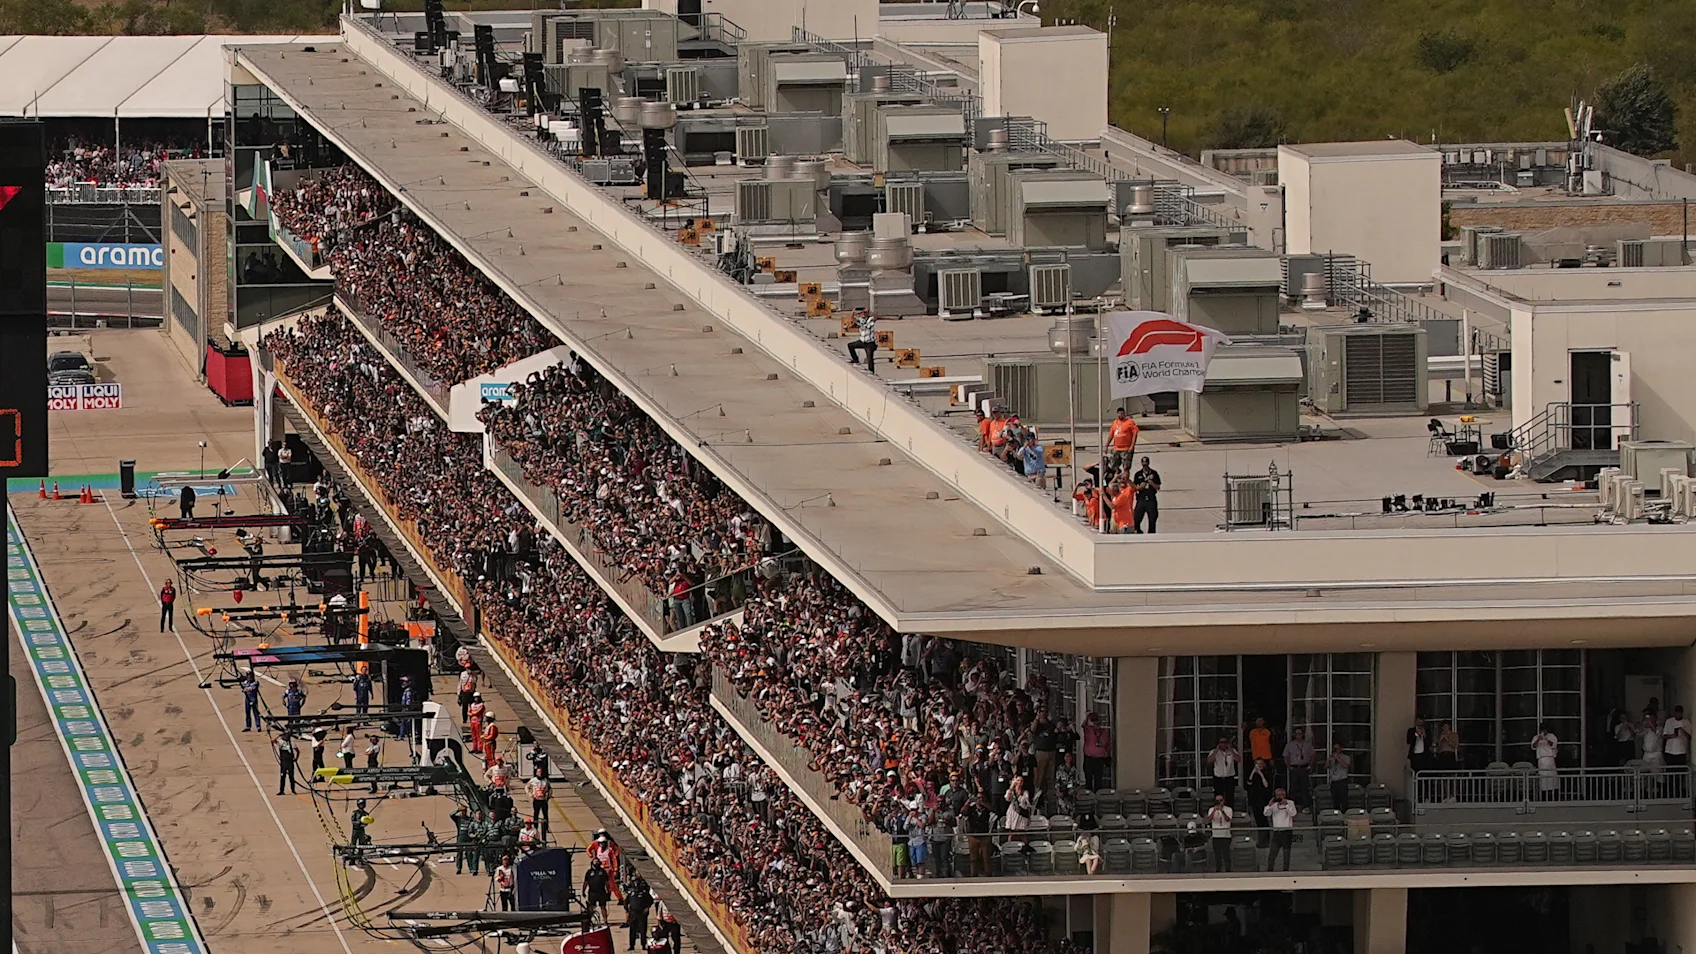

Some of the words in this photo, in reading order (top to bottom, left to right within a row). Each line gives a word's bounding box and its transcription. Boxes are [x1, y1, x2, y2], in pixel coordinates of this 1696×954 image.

[1142, 369, 1171, 379] World
[84, 386, 118, 397] LIQUI
[84, 397, 119, 409] MOLY
